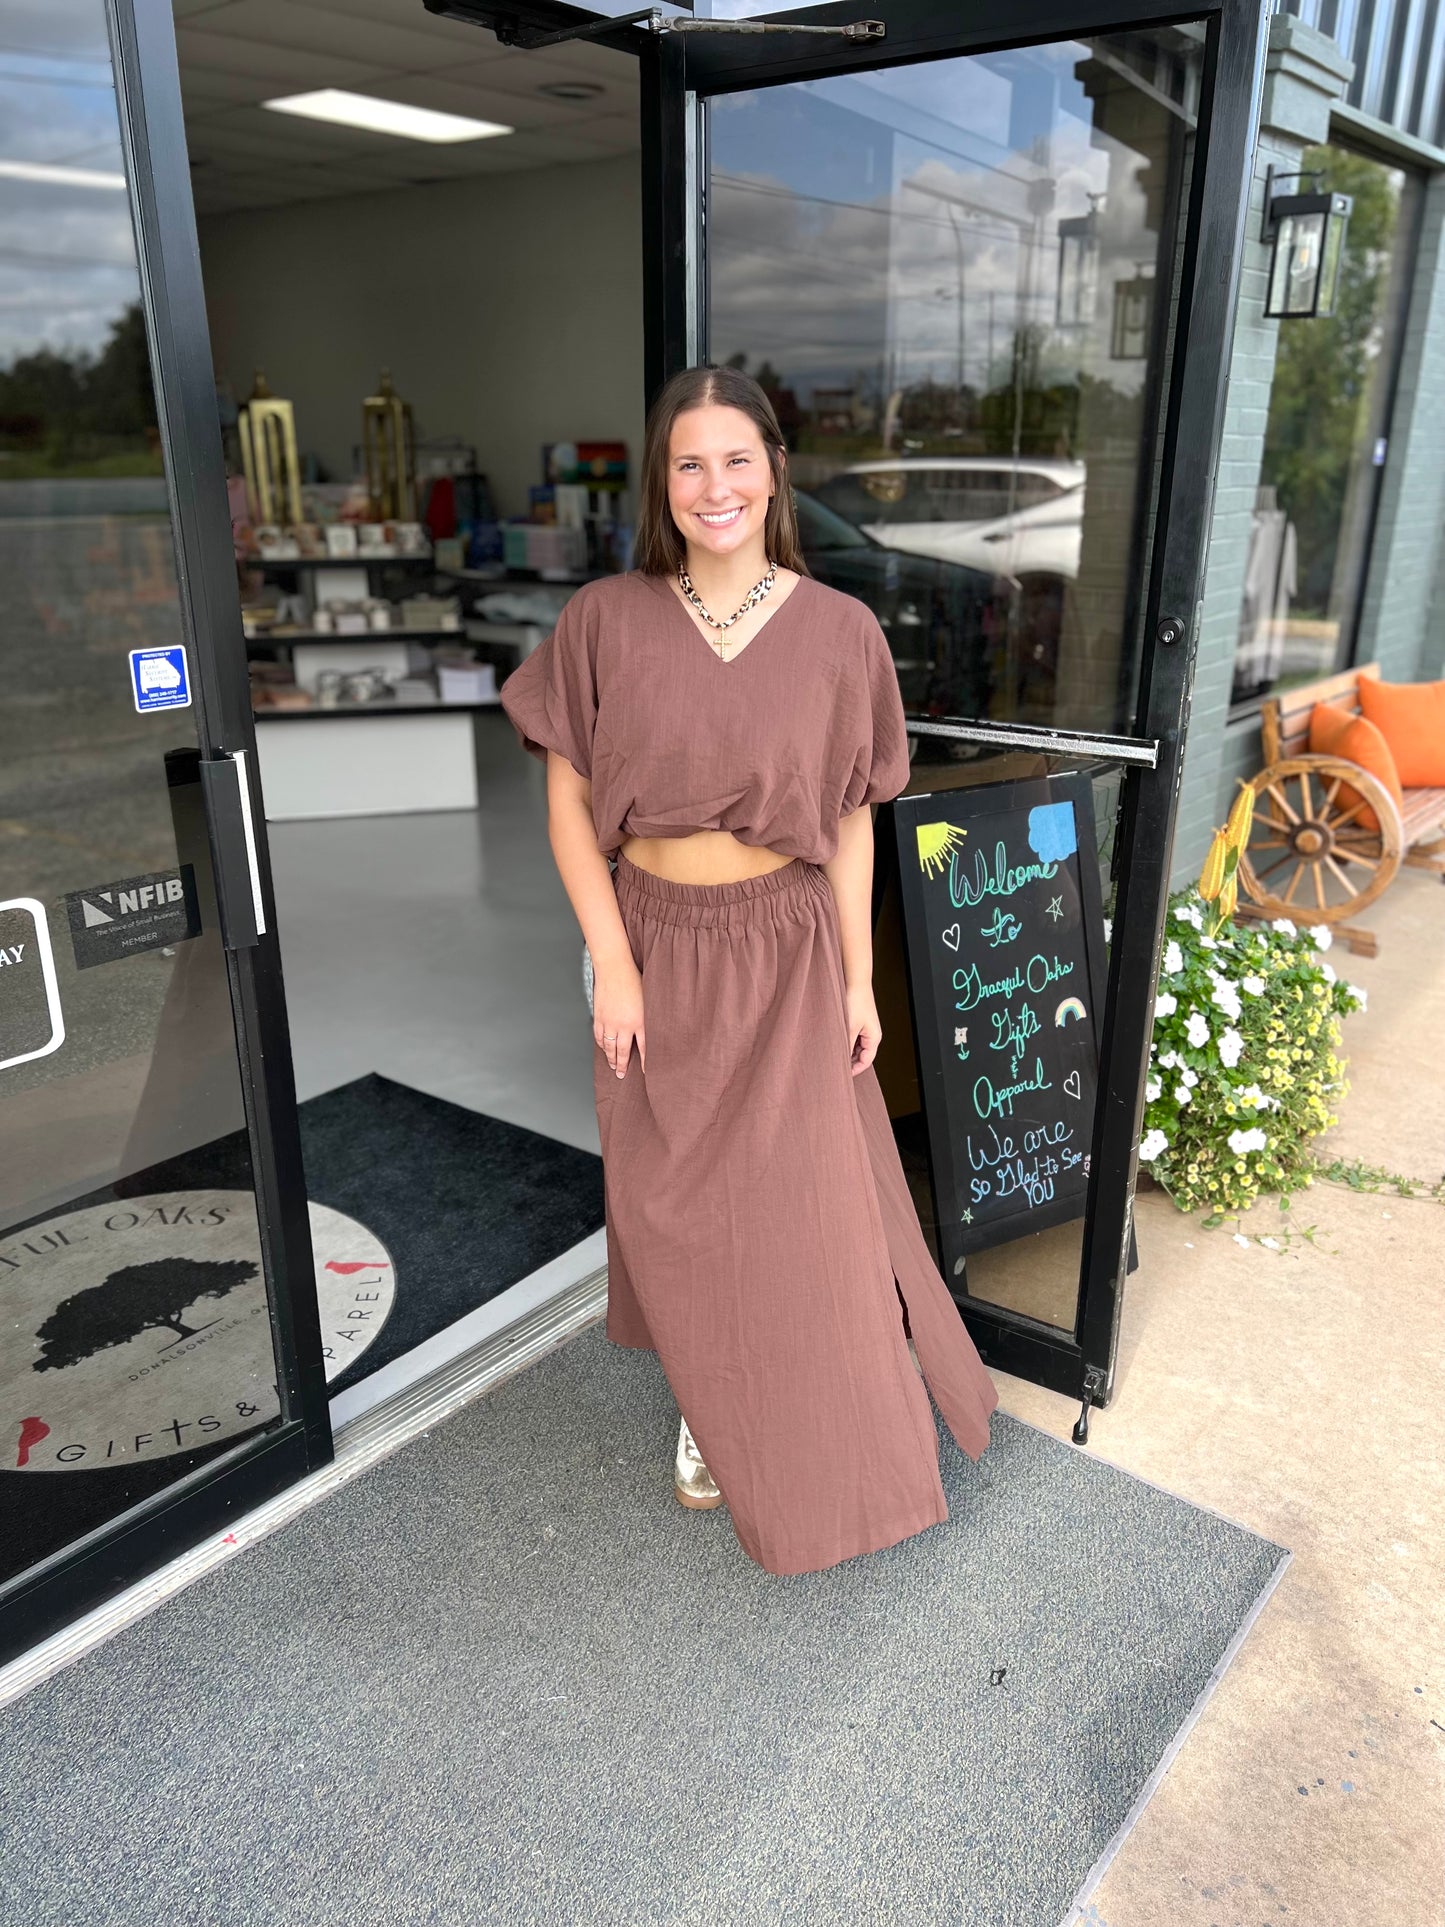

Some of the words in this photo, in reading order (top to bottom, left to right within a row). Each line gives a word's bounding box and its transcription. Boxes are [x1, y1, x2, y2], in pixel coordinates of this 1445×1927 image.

[118, 879, 184, 915] NFIB
[950, 841, 1059, 908] Welcome
[121, 932, 158, 948] MEMBER
[981, 907, 1022, 947] to
[953, 963, 1025, 1011] Graceful
[1027, 954, 1074, 993] Oaks
[989, 1002, 1041, 1059] Gifts
[973, 1057, 1053, 1118] Apparel
[967, 1124, 1019, 1171] We
[1024, 1121, 1074, 1153] are
[996, 1157, 1040, 1196] Glad
[1061, 1147, 1082, 1170] See
[0, 1231, 89, 1279] FUL
[104, 1206, 231, 1232] OAKS
[56, 1415, 221, 1463] GIFTS
[235, 1402, 261, 1417] &
